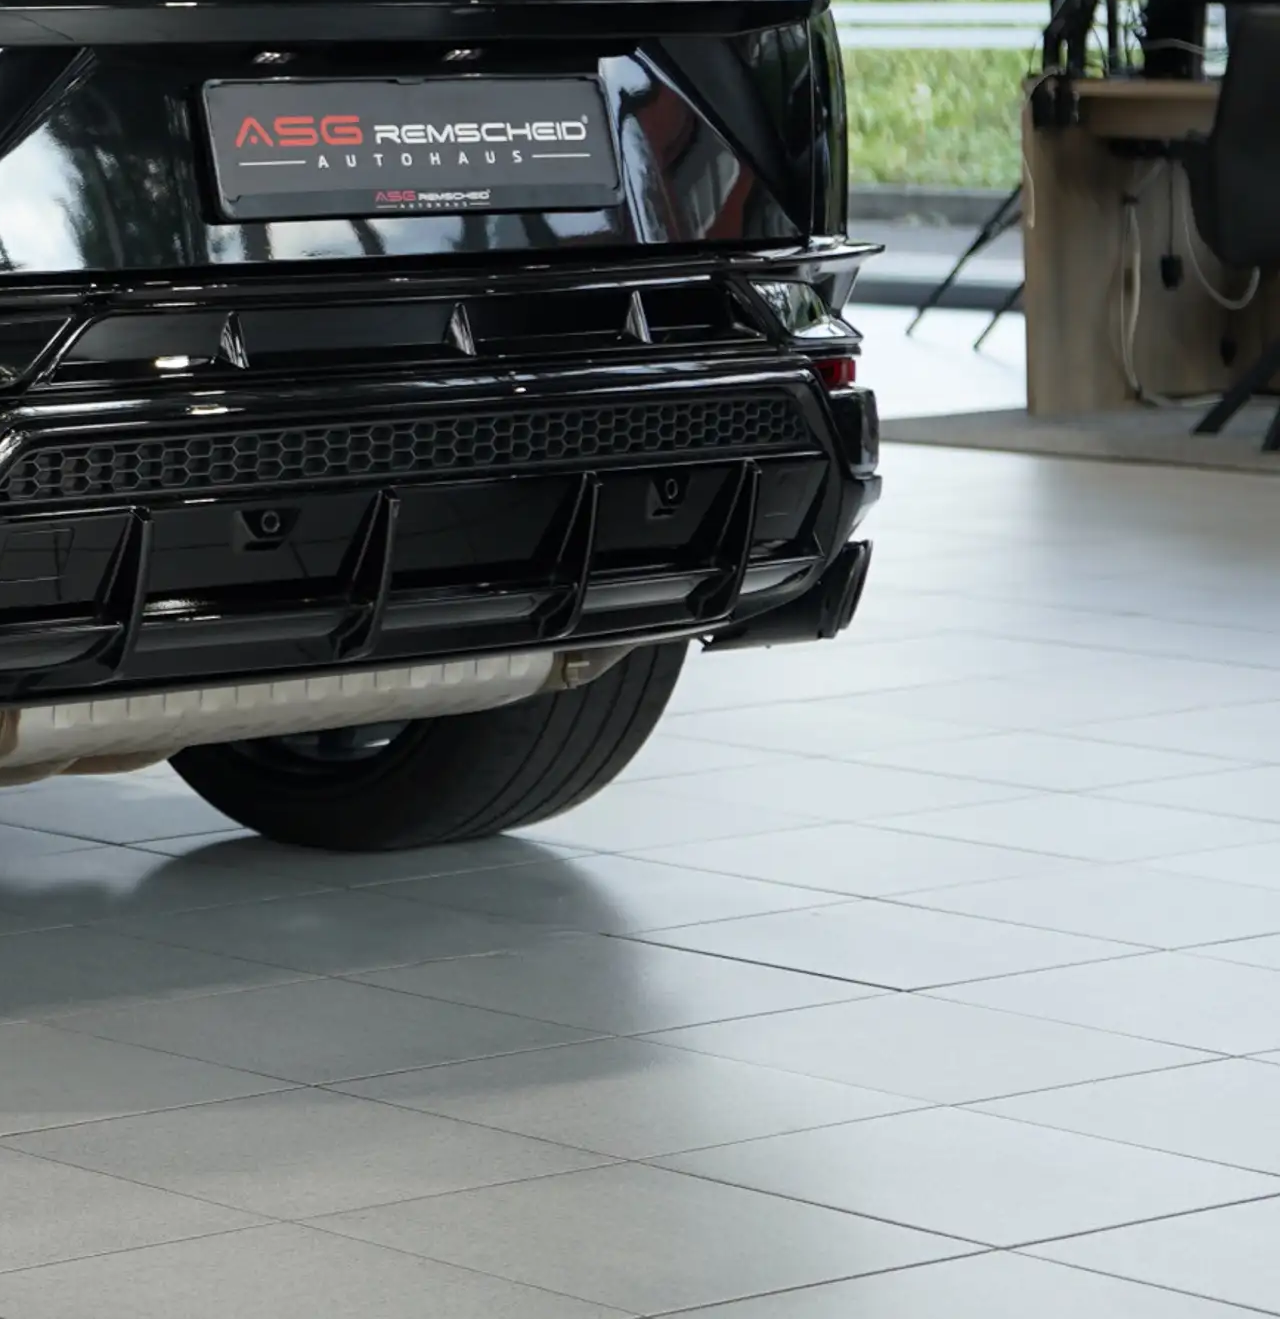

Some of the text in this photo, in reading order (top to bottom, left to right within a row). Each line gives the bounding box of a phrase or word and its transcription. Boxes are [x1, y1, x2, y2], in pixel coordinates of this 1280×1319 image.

[235, 114, 587, 148] ASG REMSCHEID
[317, 149, 524, 170] AUTOHAUS
